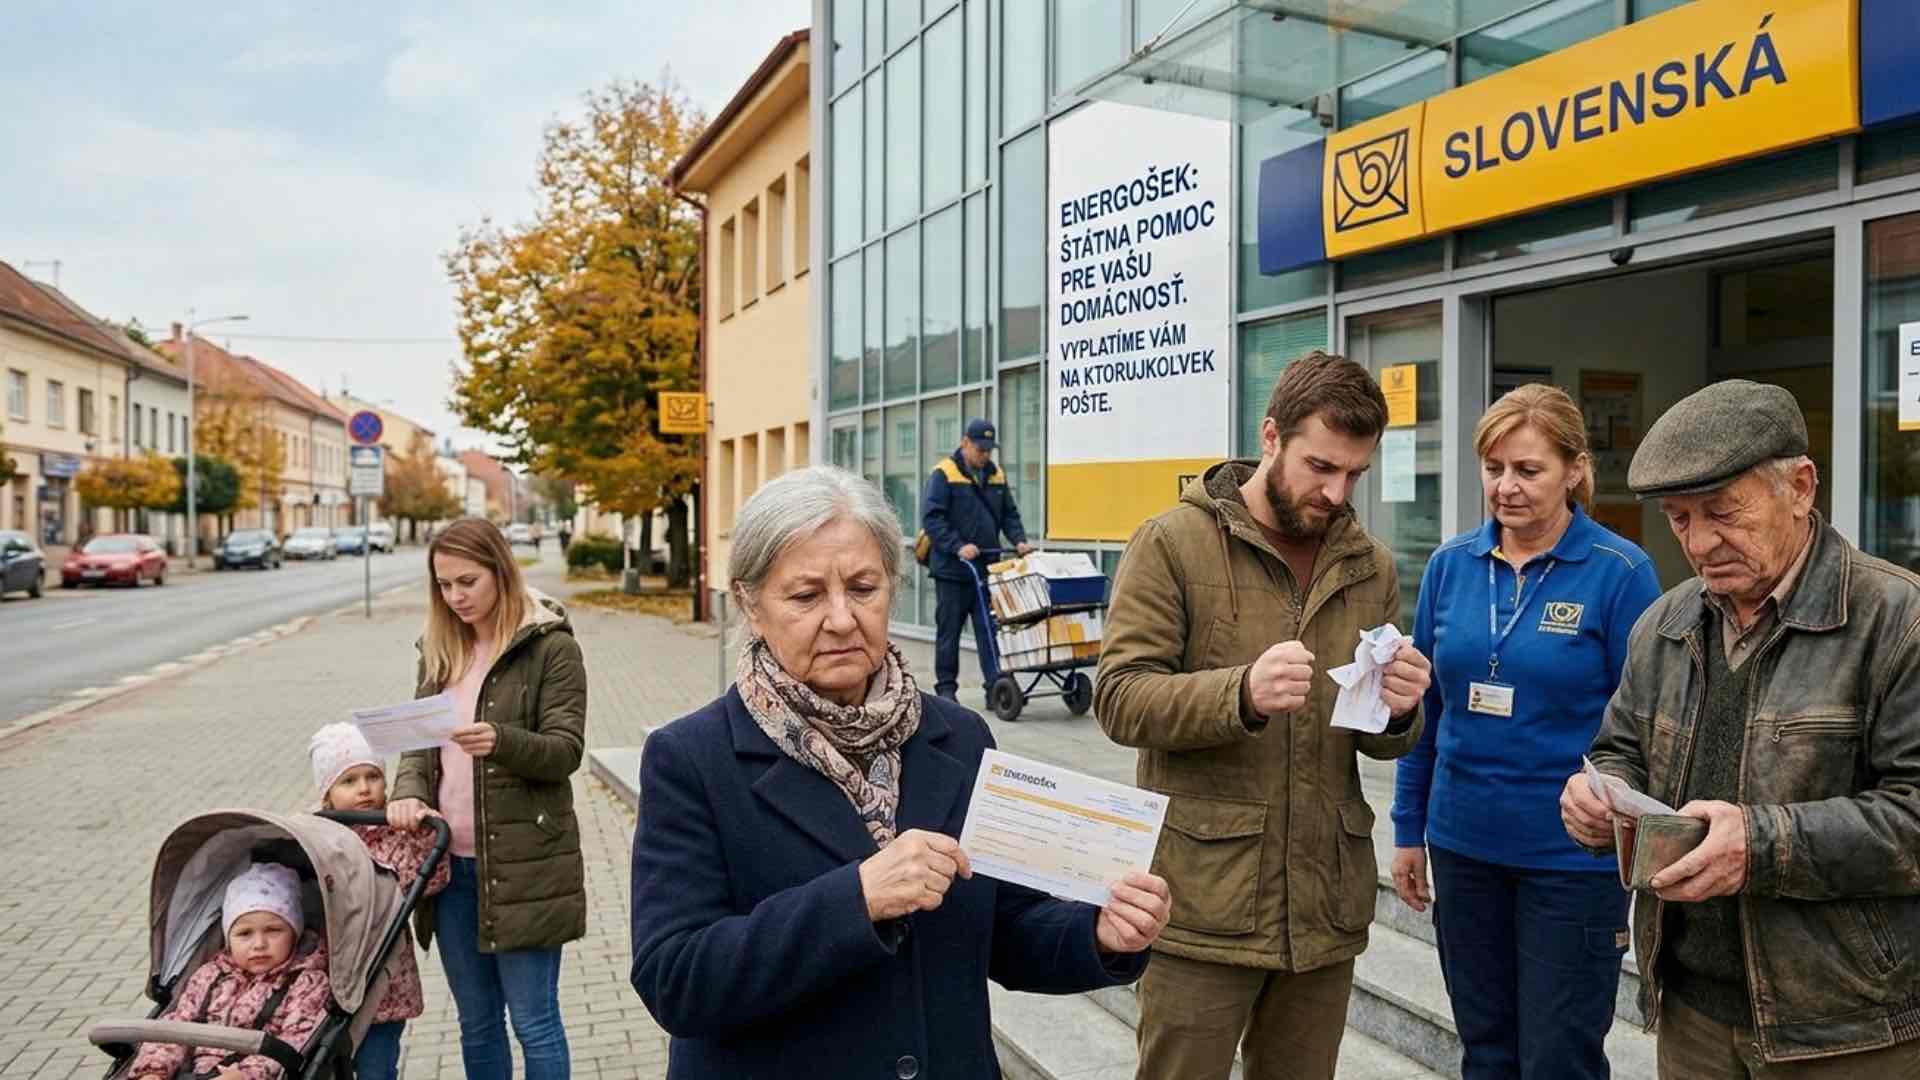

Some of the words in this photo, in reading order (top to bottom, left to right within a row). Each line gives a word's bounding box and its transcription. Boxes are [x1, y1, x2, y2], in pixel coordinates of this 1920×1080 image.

[1444, 12, 1788, 179] SLOVENSKÁ
[1061, 162, 1198, 228] ENERGOŠEK:
[1136, 200, 1215, 244] POMOC
[1061, 265, 1096, 294] PRE
[1061, 271, 1188, 326] DOMÁCNOSŤ.
[1060, 327, 1145, 361] VYPLATÍME
[1149, 320, 1187, 348] VÁM
[1060, 368, 1081, 389] NA
